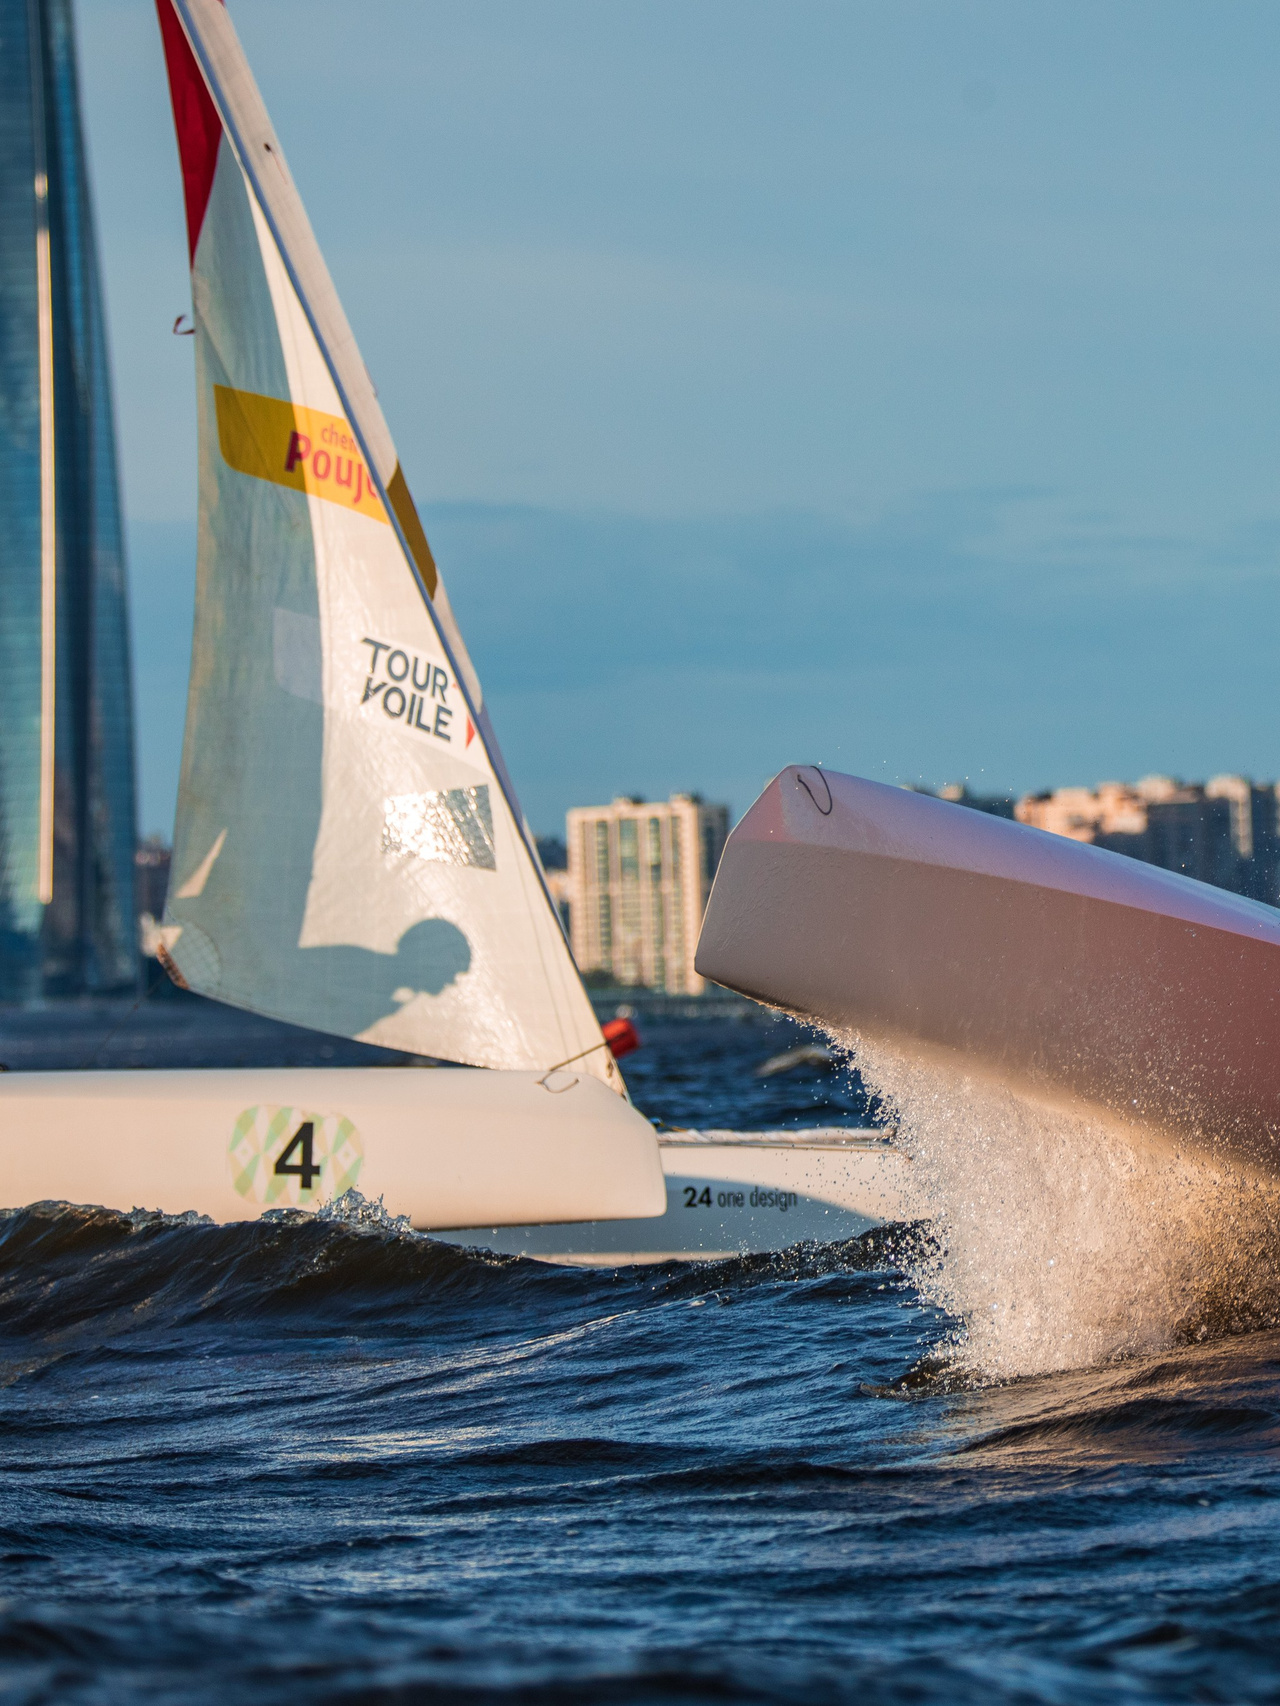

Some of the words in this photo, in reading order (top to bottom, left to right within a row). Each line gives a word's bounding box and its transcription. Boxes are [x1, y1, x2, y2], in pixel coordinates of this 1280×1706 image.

[361, 637, 448, 704] TOUR
[360, 676, 453, 743] VOILE
[274, 1122, 320, 1189] 4
[683, 1186, 712, 1208] 24
[717, 1191, 745, 1208] one
[749, 1185, 798, 1212] design
